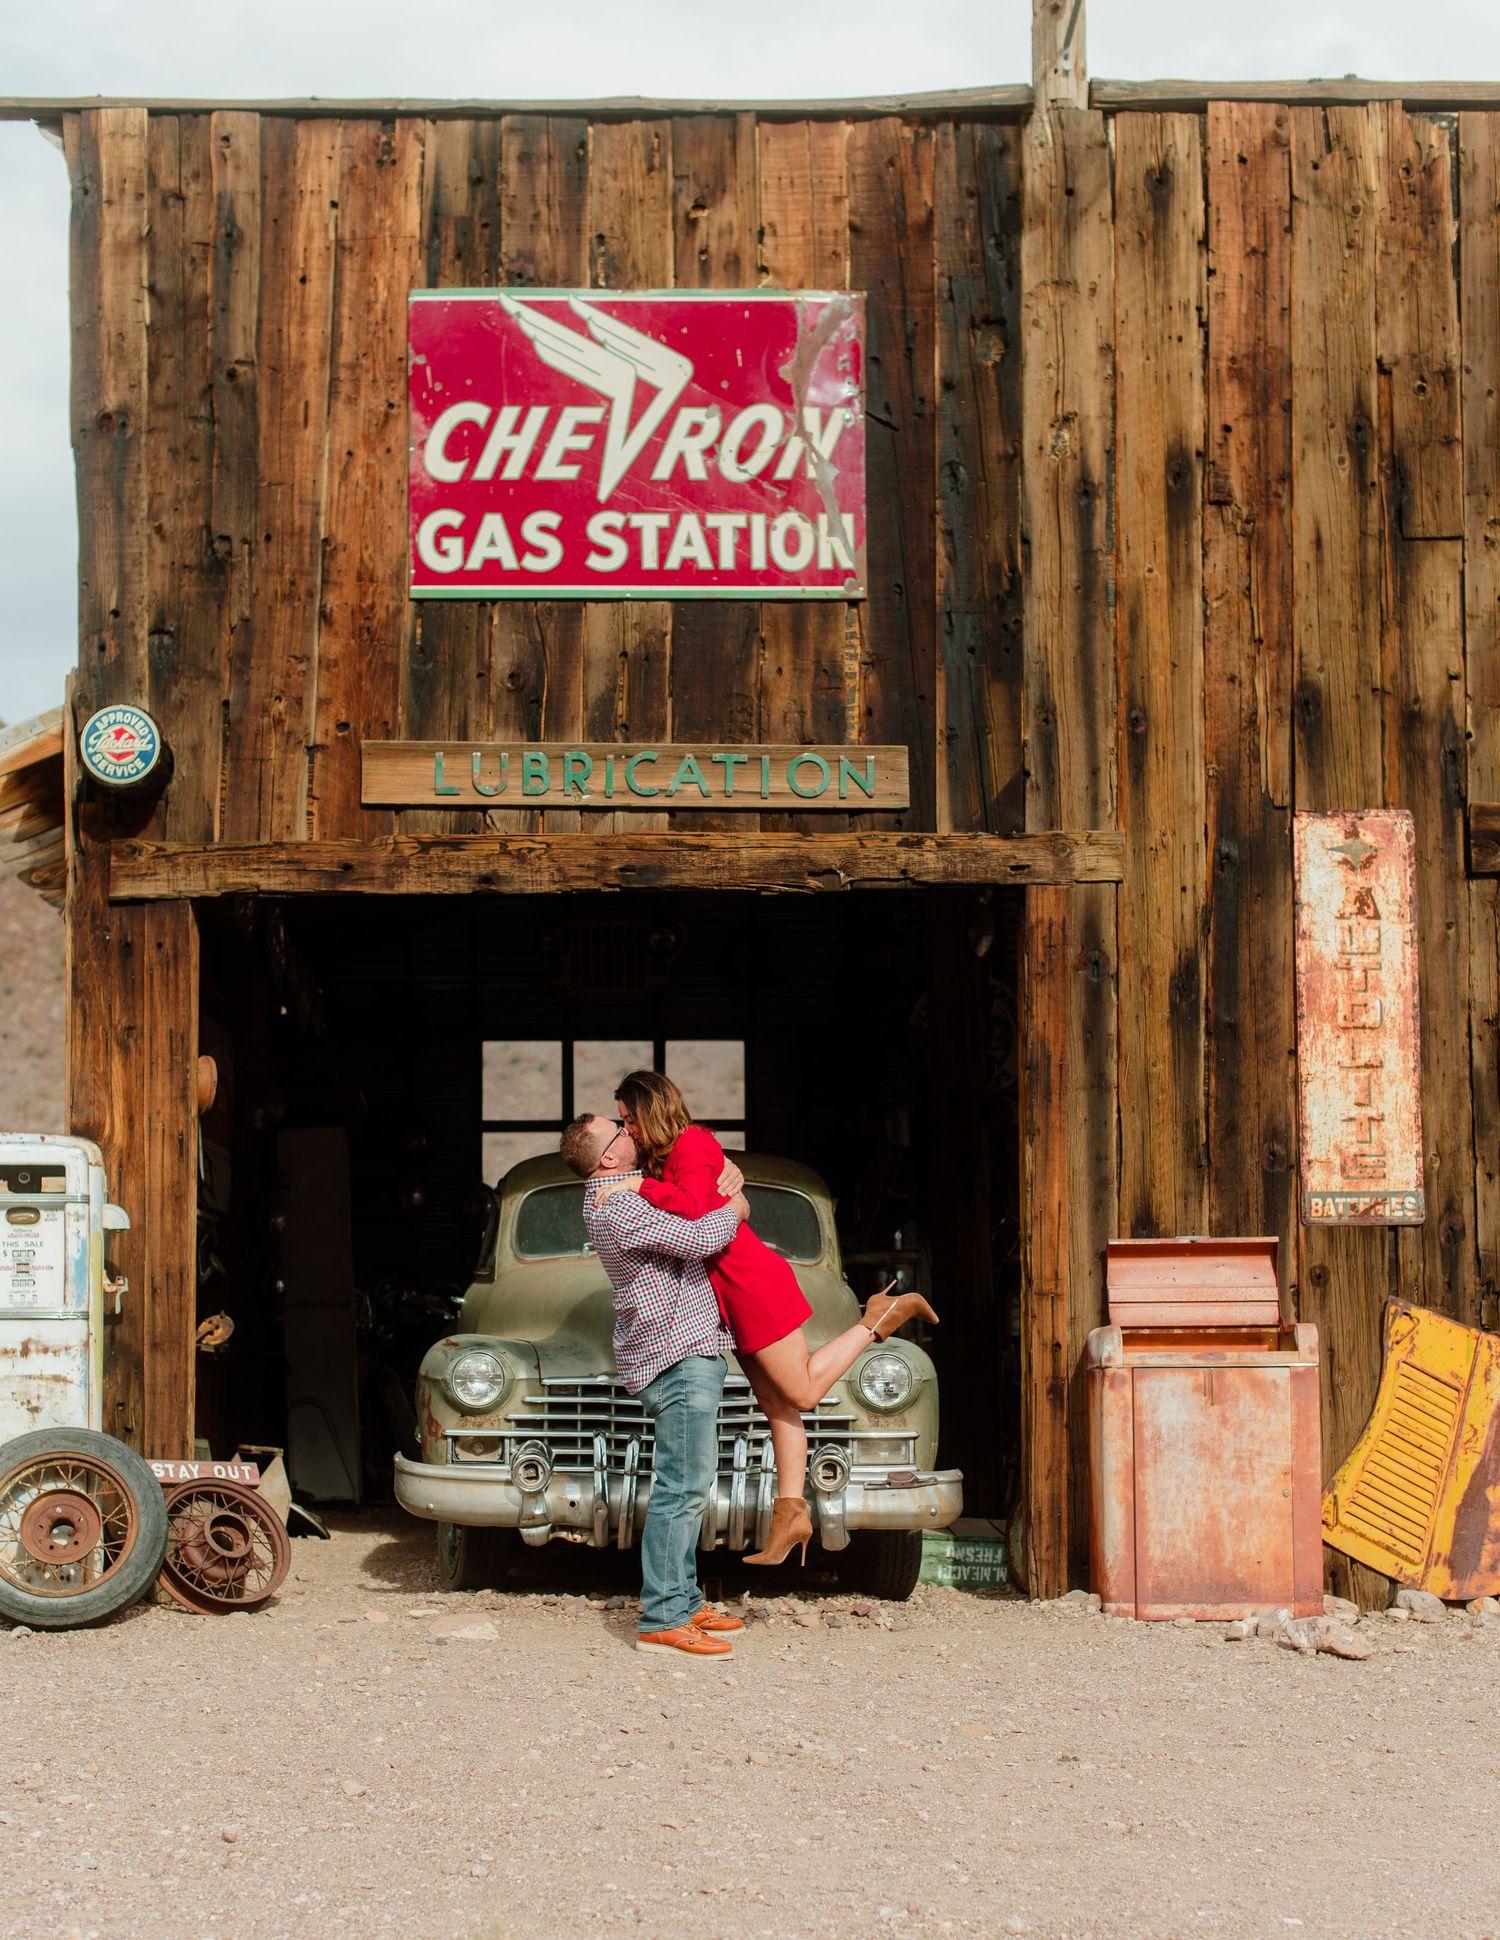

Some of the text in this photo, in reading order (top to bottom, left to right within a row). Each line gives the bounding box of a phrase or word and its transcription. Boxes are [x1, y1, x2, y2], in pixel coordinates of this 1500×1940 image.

[423, 391, 849, 503] CHEVRON
[417, 508, 856, 573] GAS STATION
[95, 711, 150, 736] APPROVED
[88, 730, 153, 754] Packard
[92, 752, 146, 777] SERVICE
[434, 751, 876, 799] LUBRICATION
[1310, 1196, 1418, 1217] BATTERIES
[151, 1462, 251, 1480] STAY OUT
